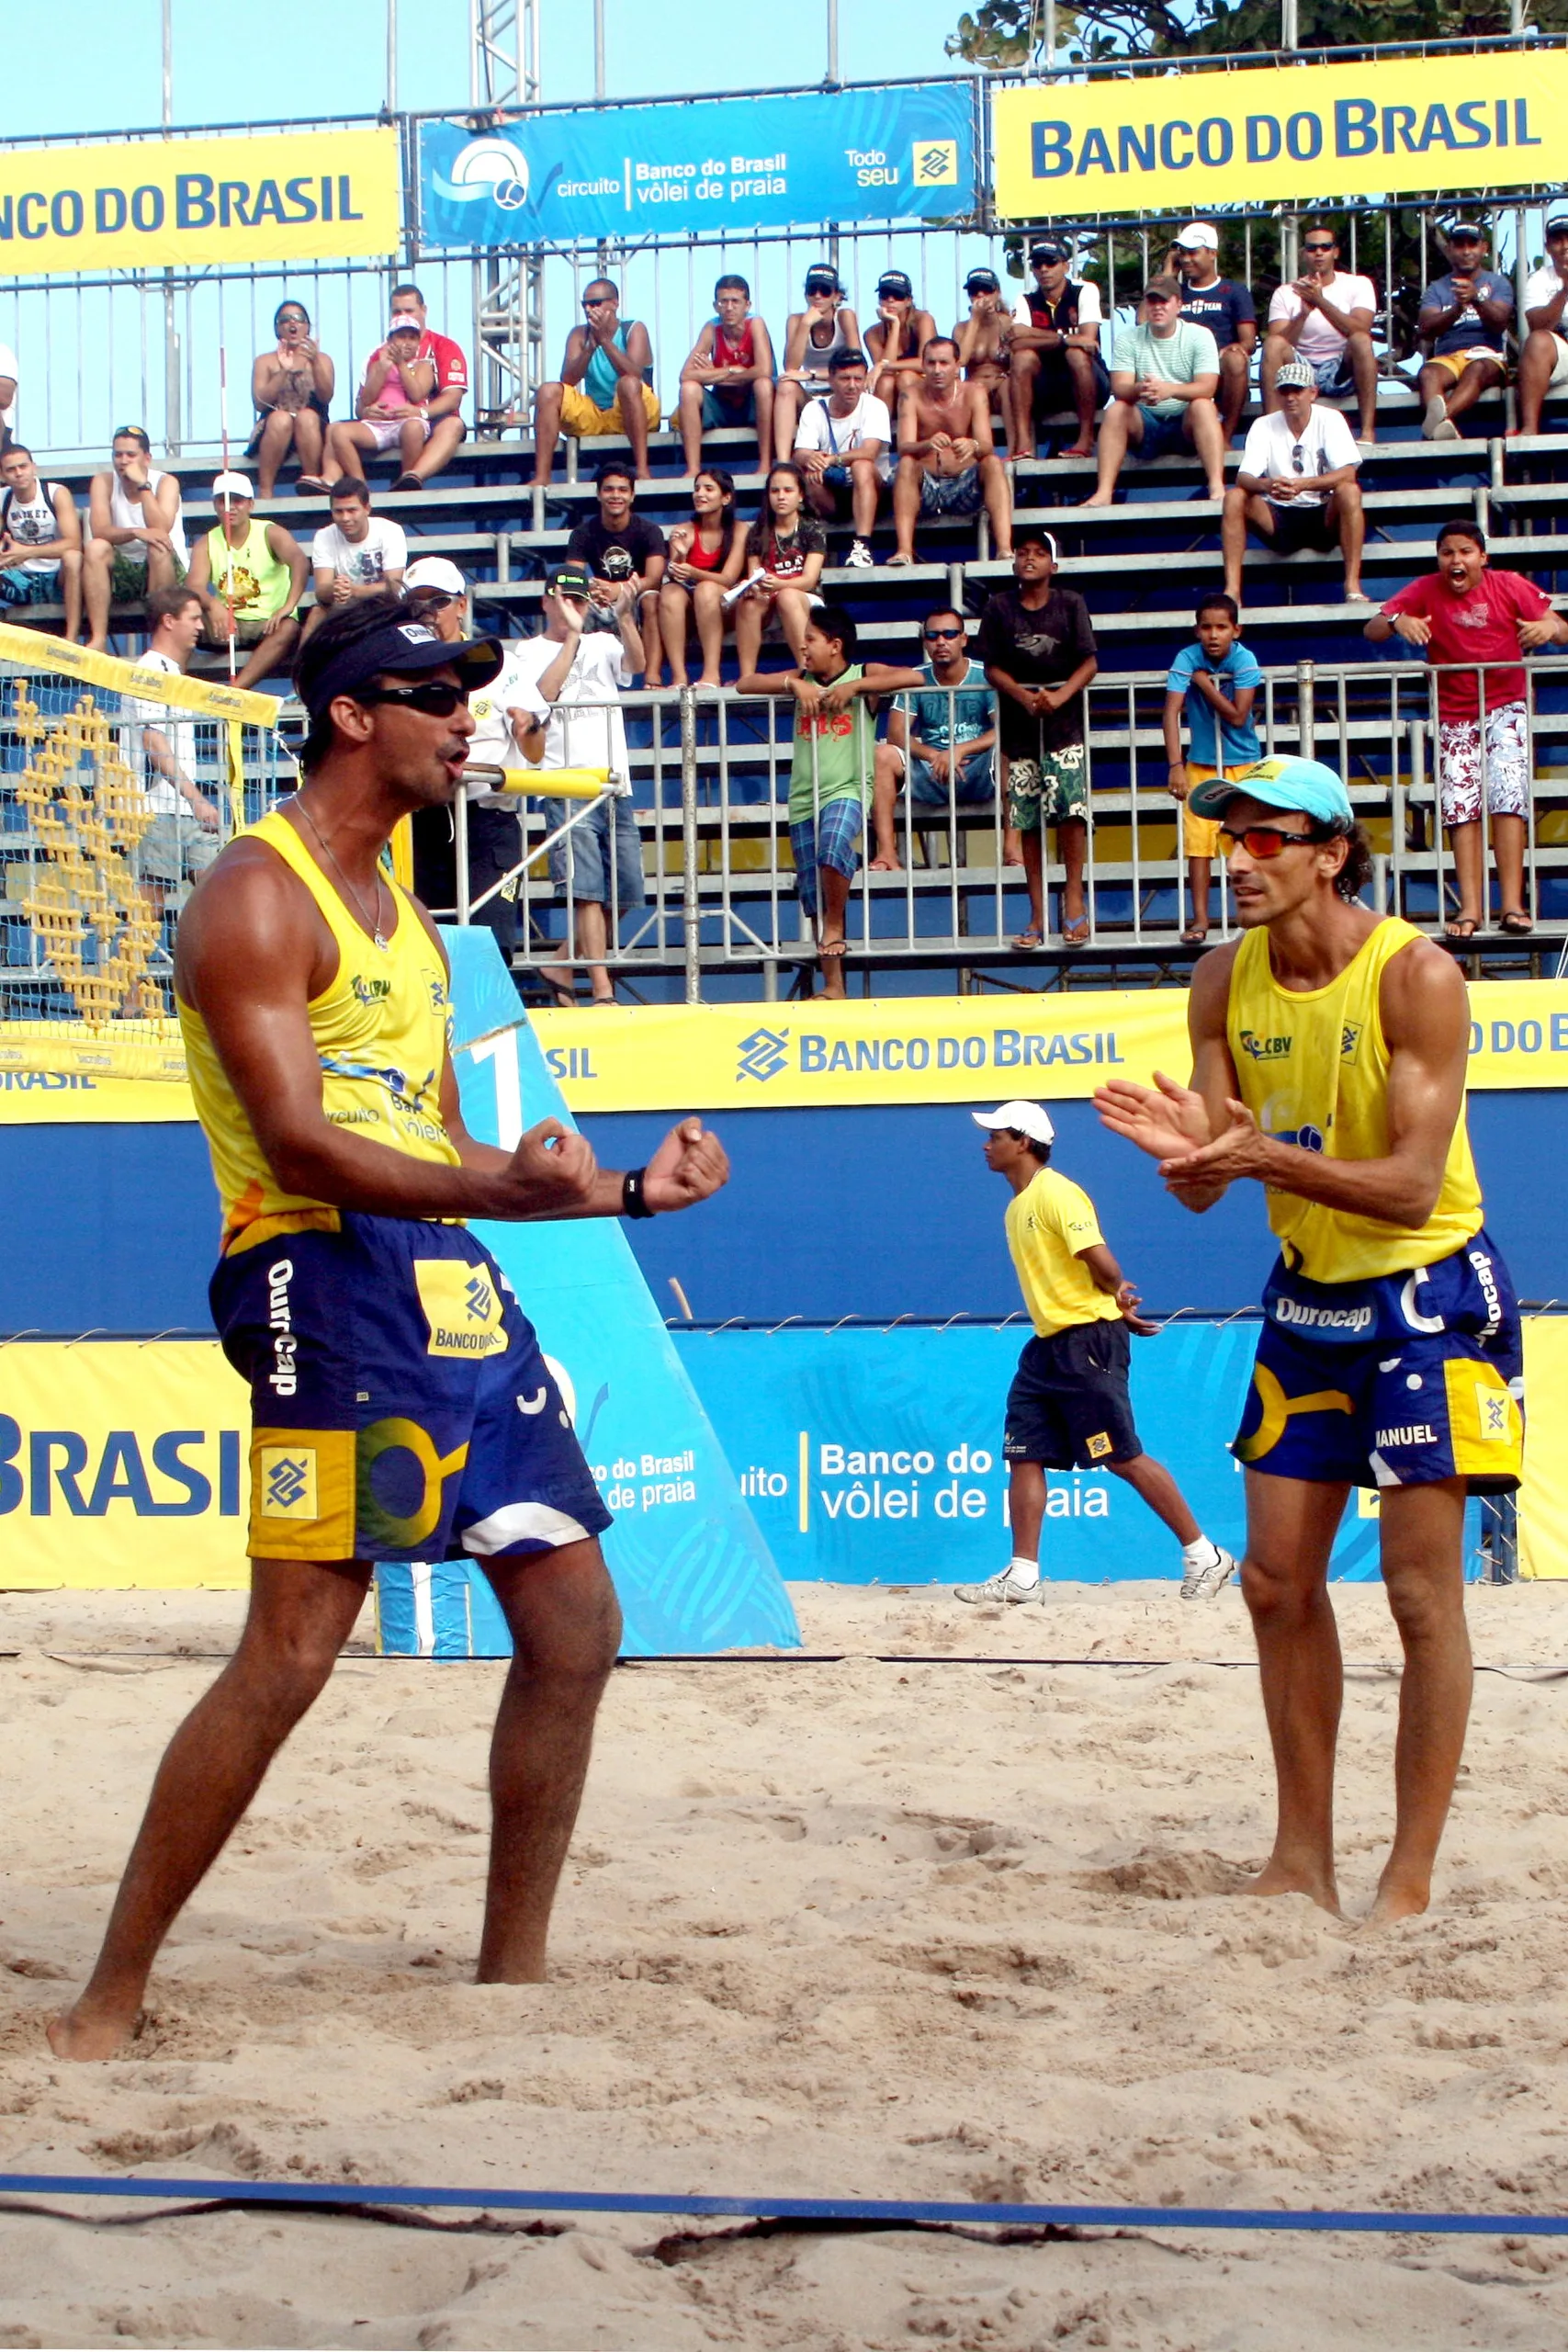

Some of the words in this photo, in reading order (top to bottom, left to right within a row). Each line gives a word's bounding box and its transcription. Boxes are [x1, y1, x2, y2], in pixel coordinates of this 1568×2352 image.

[1031, 117, 1234, 178] BANCO
[1247, 110, 1323, 164] DO
[1334, 97, 1542, 158] BRASIL
[844, 149, 886, 168] Todo
[557, 177, 620, 198] circuito
[635, 160, 695, 182] Banco
[701, 158, 726, 177] do
[730, 153, 786, 175] Brasil
[636, 180, 689, 204] vôlei
[695, 177, 723, 199] de
[730, 174, 787, 203] praia
[856, 168, 900, 187] seu
[95, 185, 164, 234] DO
[175, 173, 364, 230] BRASIL
[799, 1035, 929, 1072] BANCO
[937, 1036, 987, 1069] DO
[993, 1029, 1125, 1068] BRASIL
[1264, 1036, 1292, 1054] CBV
[1491, 1020, 1543, 1053] DO
[612, 1457, 637, 1480] do
[639, 1450, 695, 1477] Brasil
[819, 1443, 935, 1475] Banco
[945, 1442, 992, 1475] do
[607, 1483, 636, 1510] de
[641, 1476, 696, 1512] praia
[819, 1480, 919, 1520] vôlei
[933, 1479, 987, 1519] de
